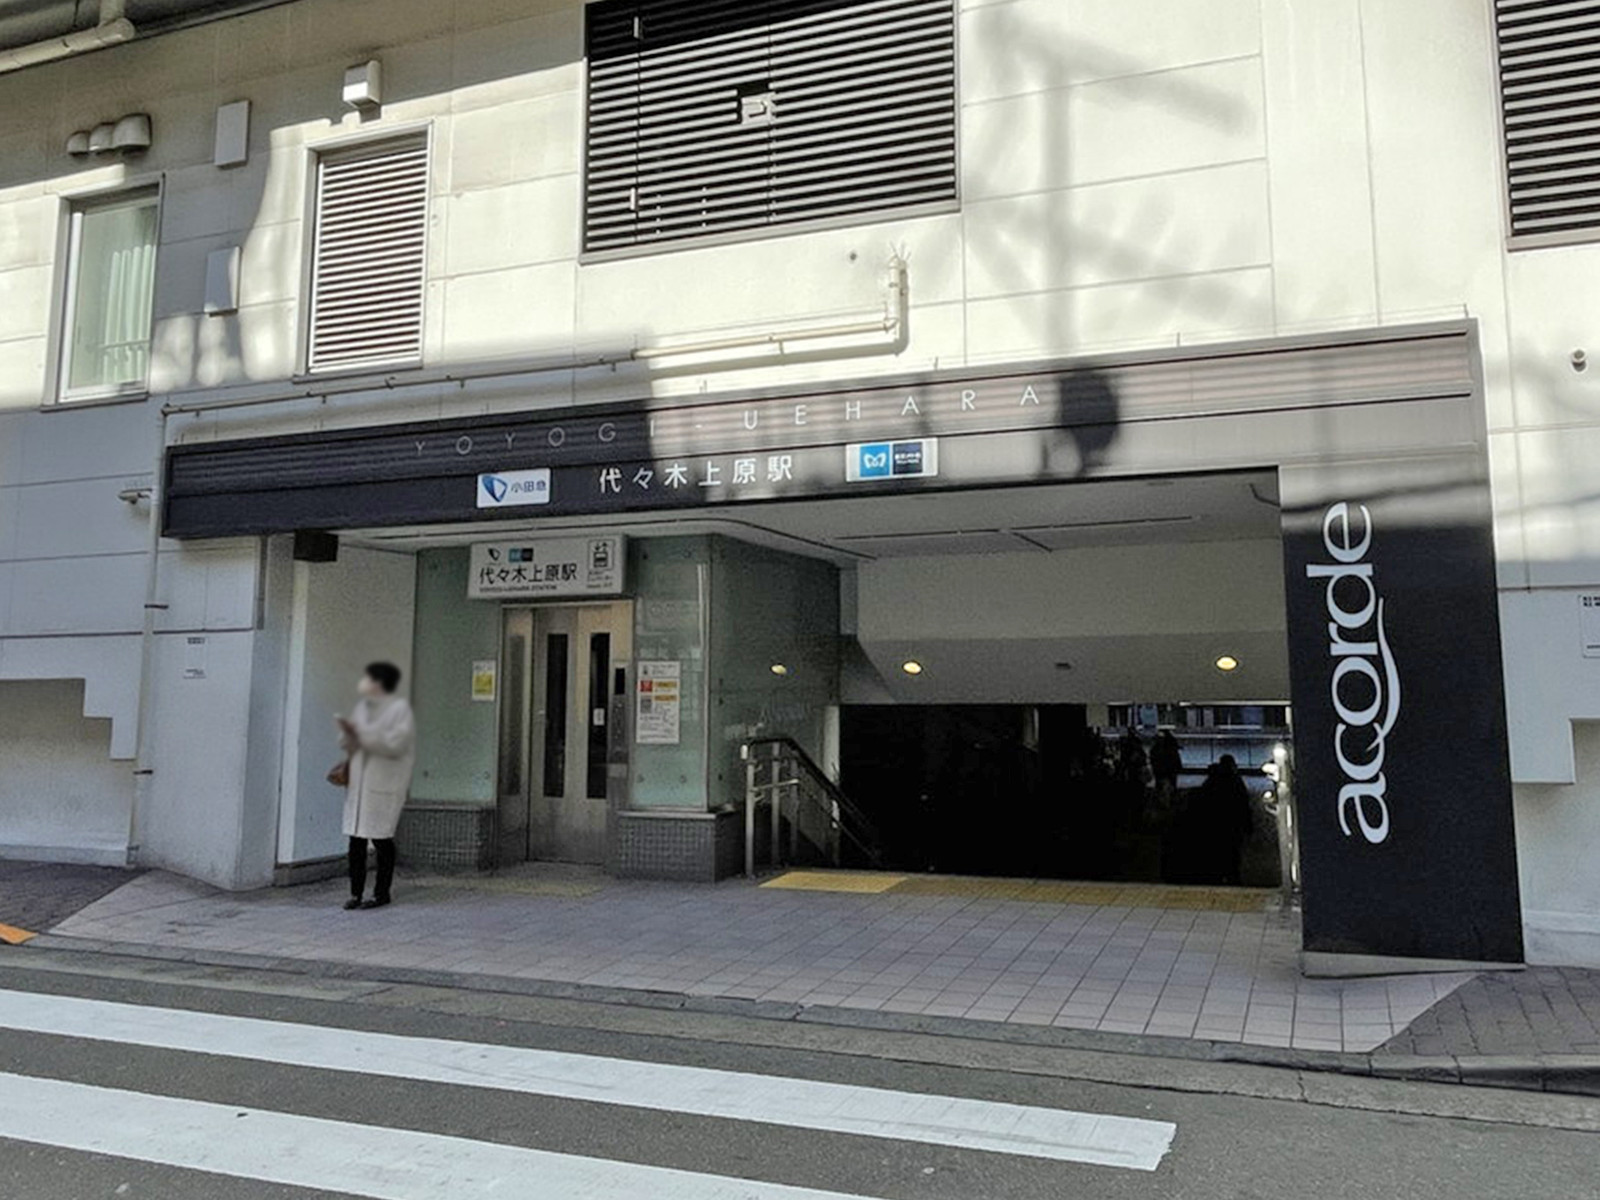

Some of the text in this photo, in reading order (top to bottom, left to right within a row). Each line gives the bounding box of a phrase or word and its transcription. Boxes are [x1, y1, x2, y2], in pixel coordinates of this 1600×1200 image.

[511, 480, 547, 494] 小田急
[600, 455, 792, 493] 代々木上原駅
[480, 563, 577, 584] 代々木上原駅
[1306, 501, 1402, 844] acorde
